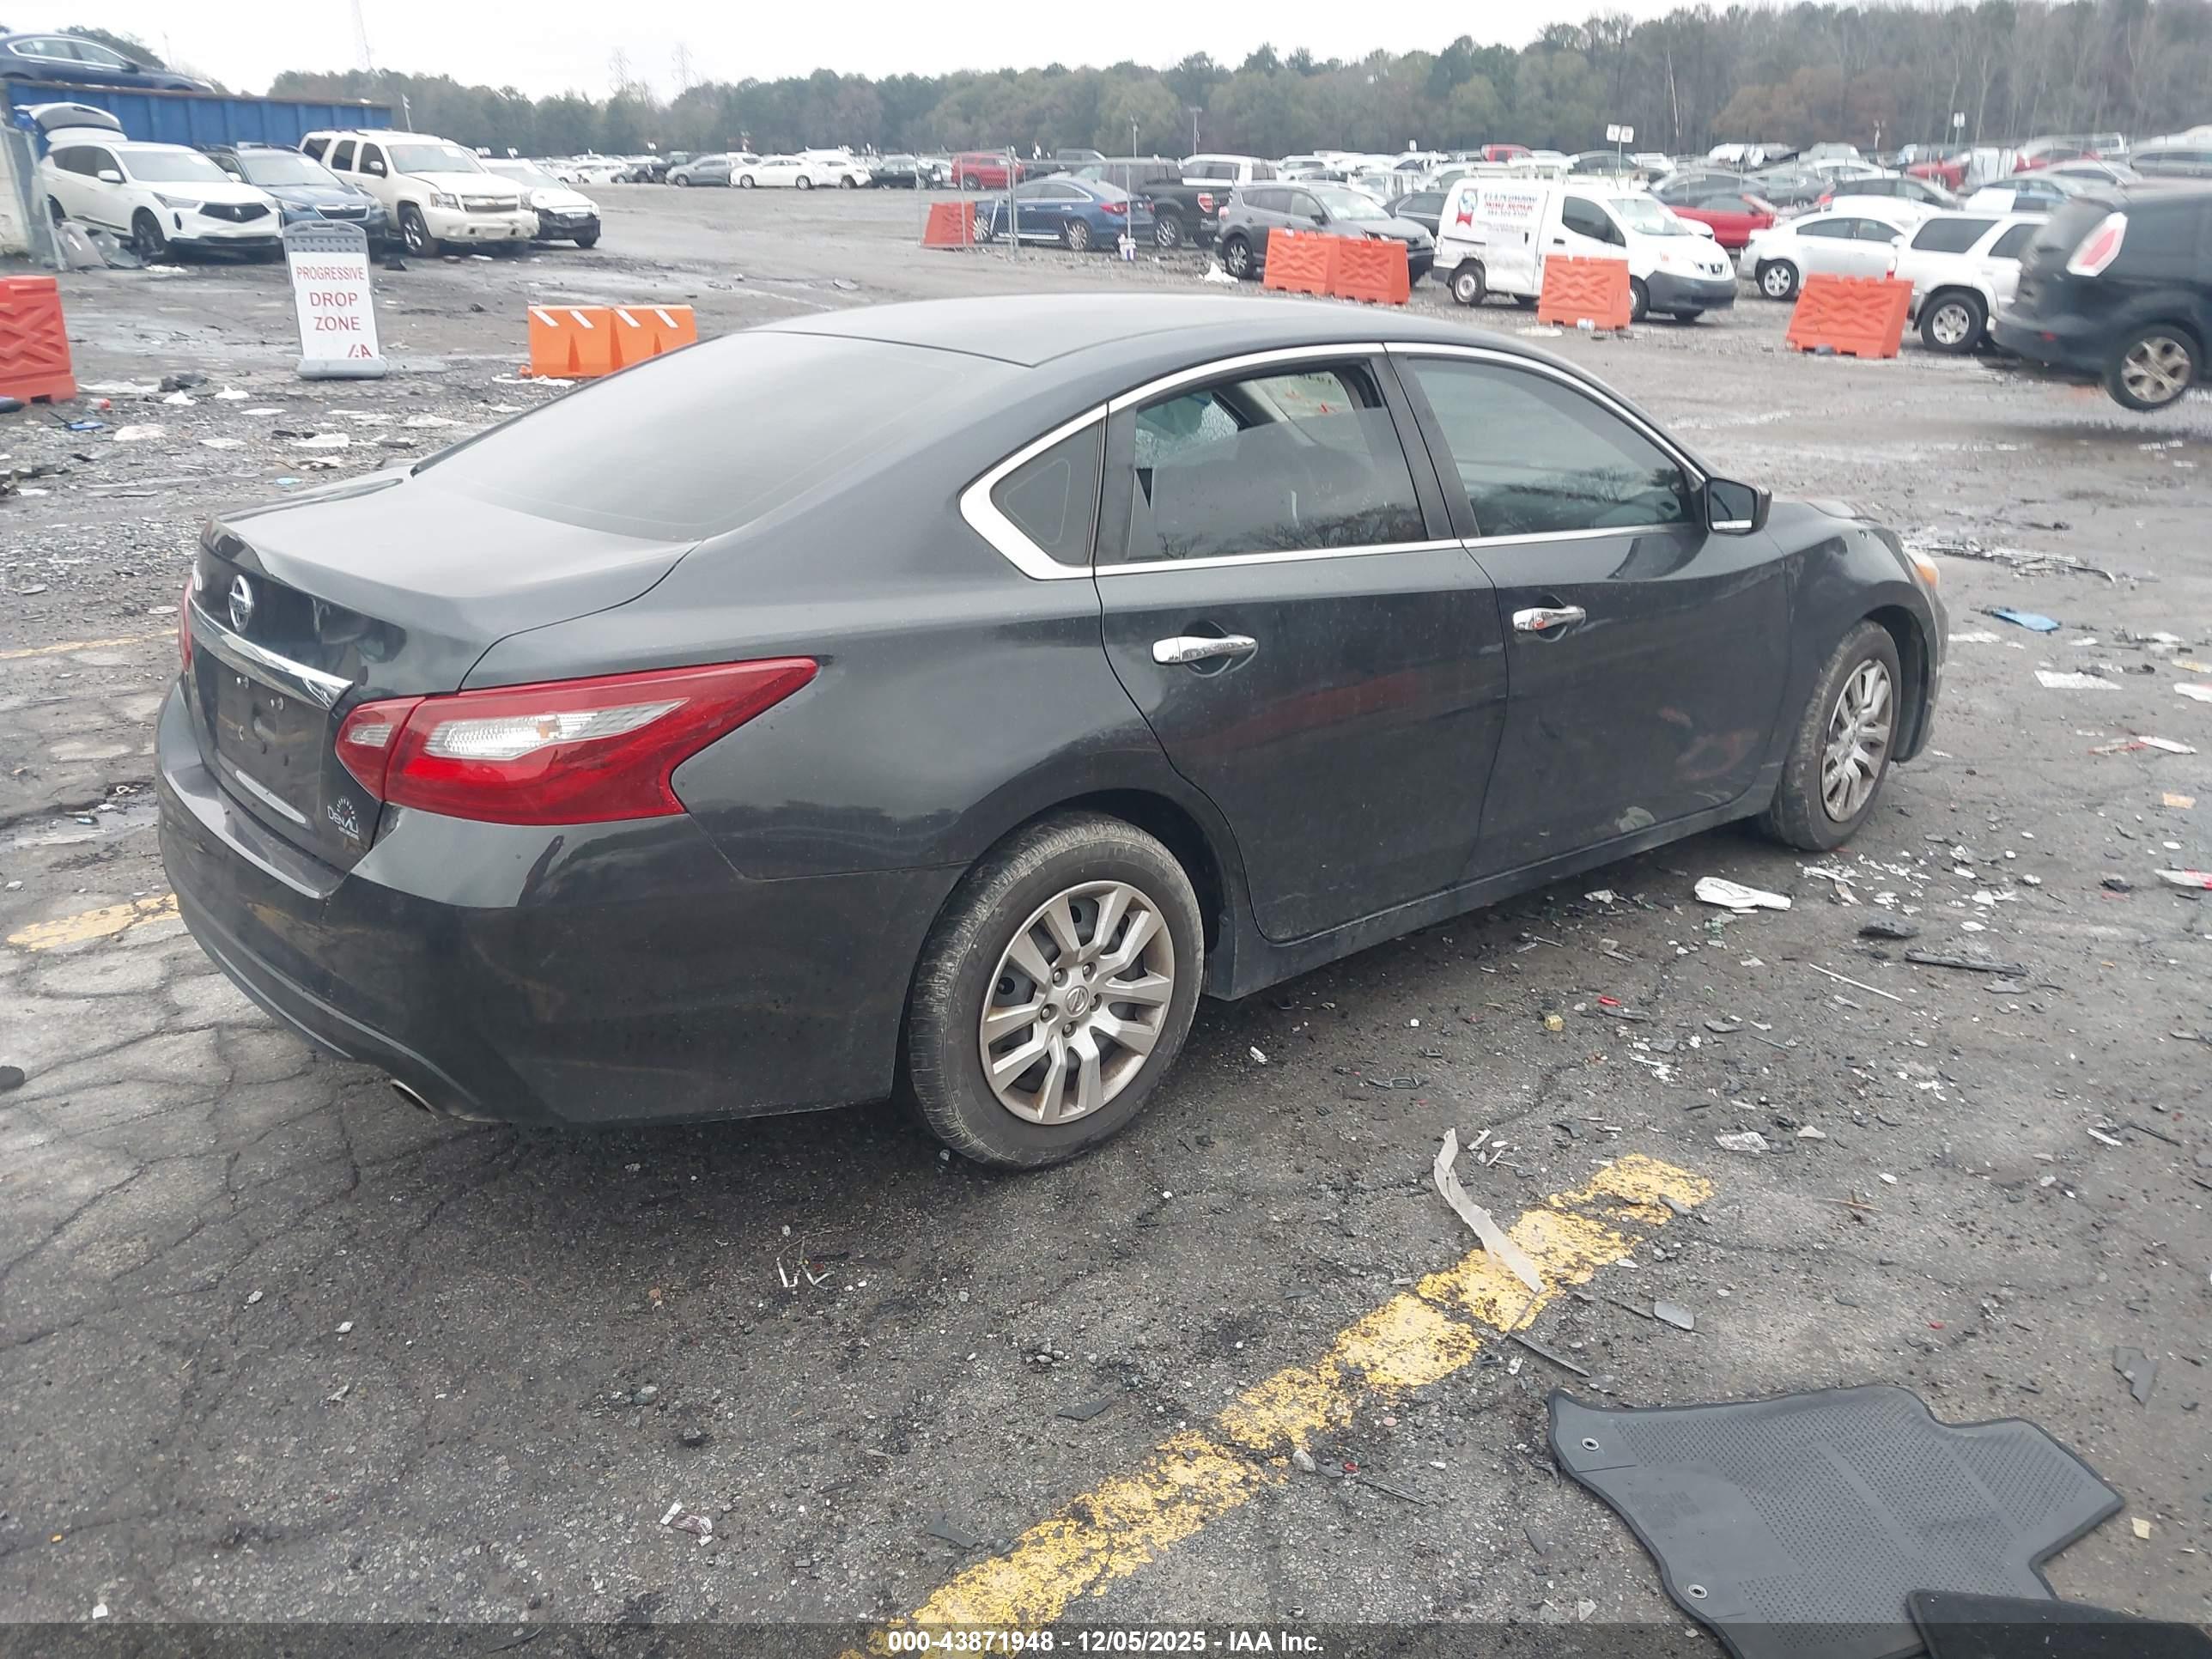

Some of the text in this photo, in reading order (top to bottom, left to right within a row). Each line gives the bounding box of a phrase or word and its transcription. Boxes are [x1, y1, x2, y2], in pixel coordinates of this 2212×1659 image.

[296, 266, 365, 281] PROGRESSIVE
[309, 292, 358, 307] DROP
[313, 316, 361, 331] ZONE
